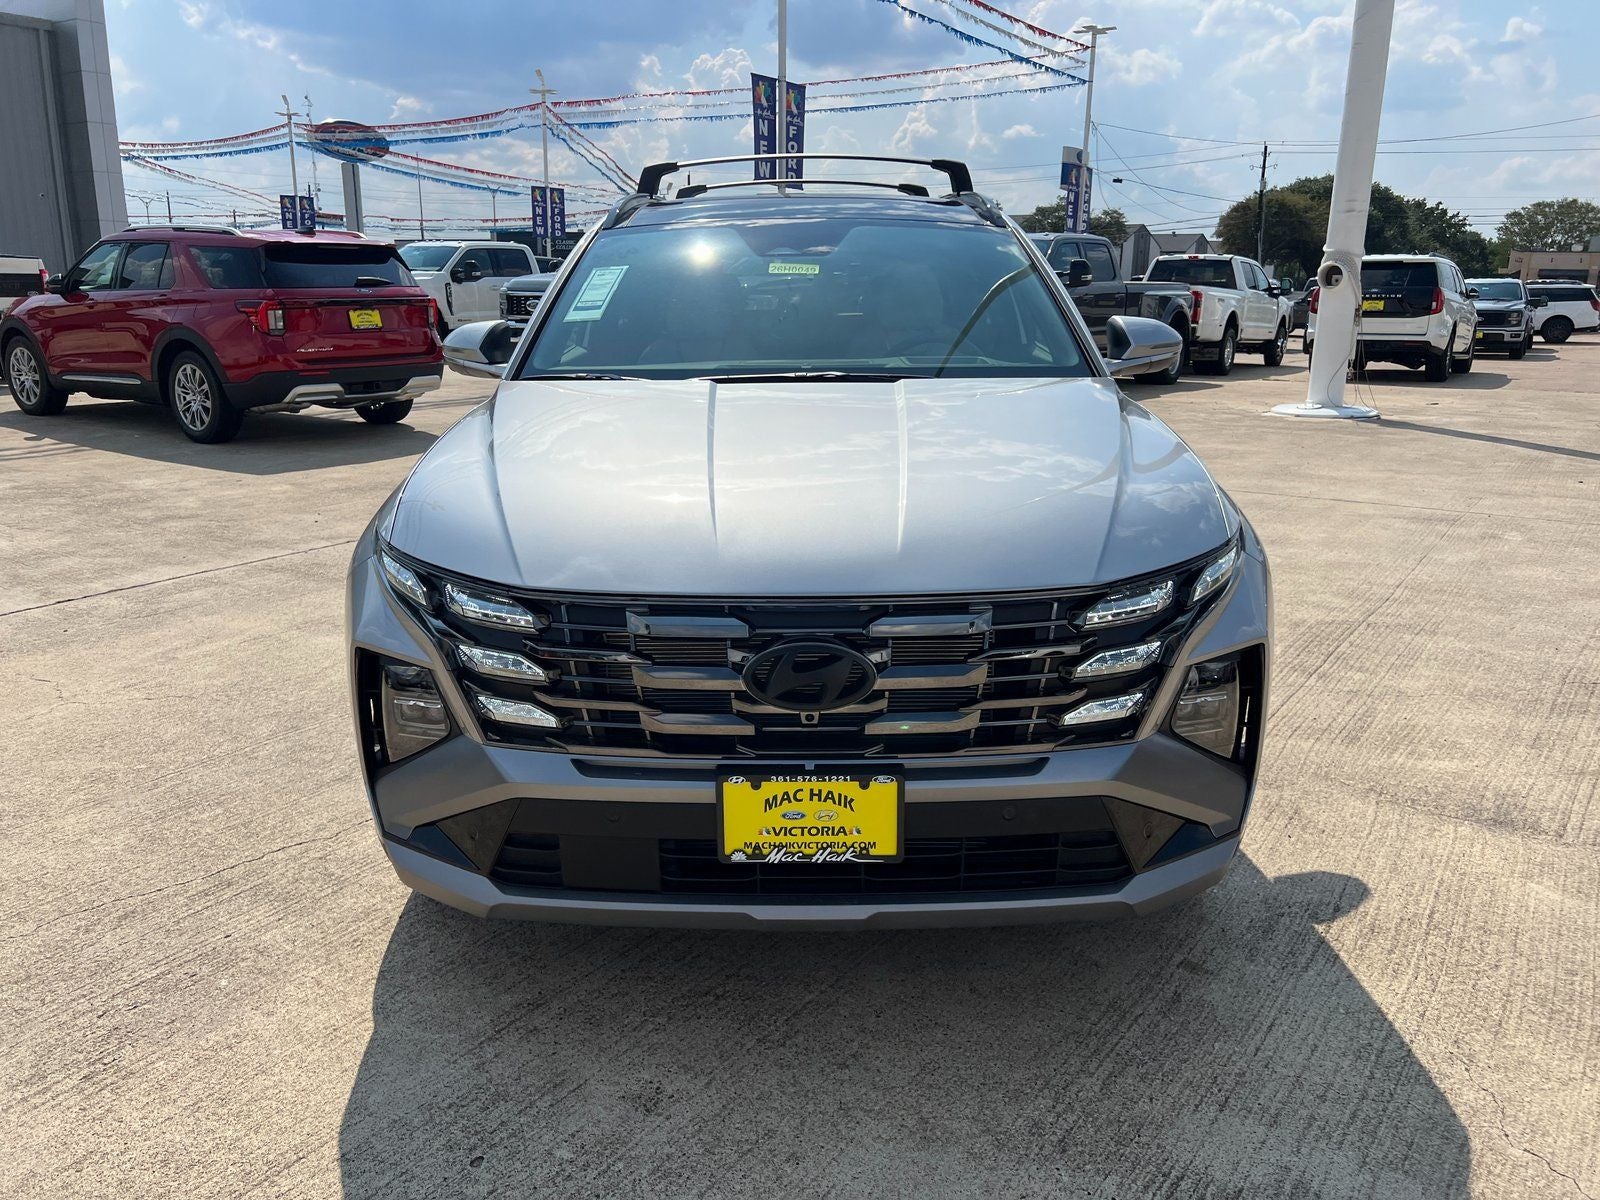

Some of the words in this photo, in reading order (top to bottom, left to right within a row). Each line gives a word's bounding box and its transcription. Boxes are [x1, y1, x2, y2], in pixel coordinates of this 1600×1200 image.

[759, 119, 771, 178] NEW
[788, 126, 797, 179] FORD
[536, 207, 544, 235] NEW
[1067, 192, 1075, 228] NEW
[770, 775, 851, 783] 361-576-1221
[764, 788, 804, 813] MAC
[809, 788, 855, 812] HAIK
[772, 826, 848, 836] VICTORIA
[766, 847, 804, 864] Mac
[811, 847, 858, 864] Haik
